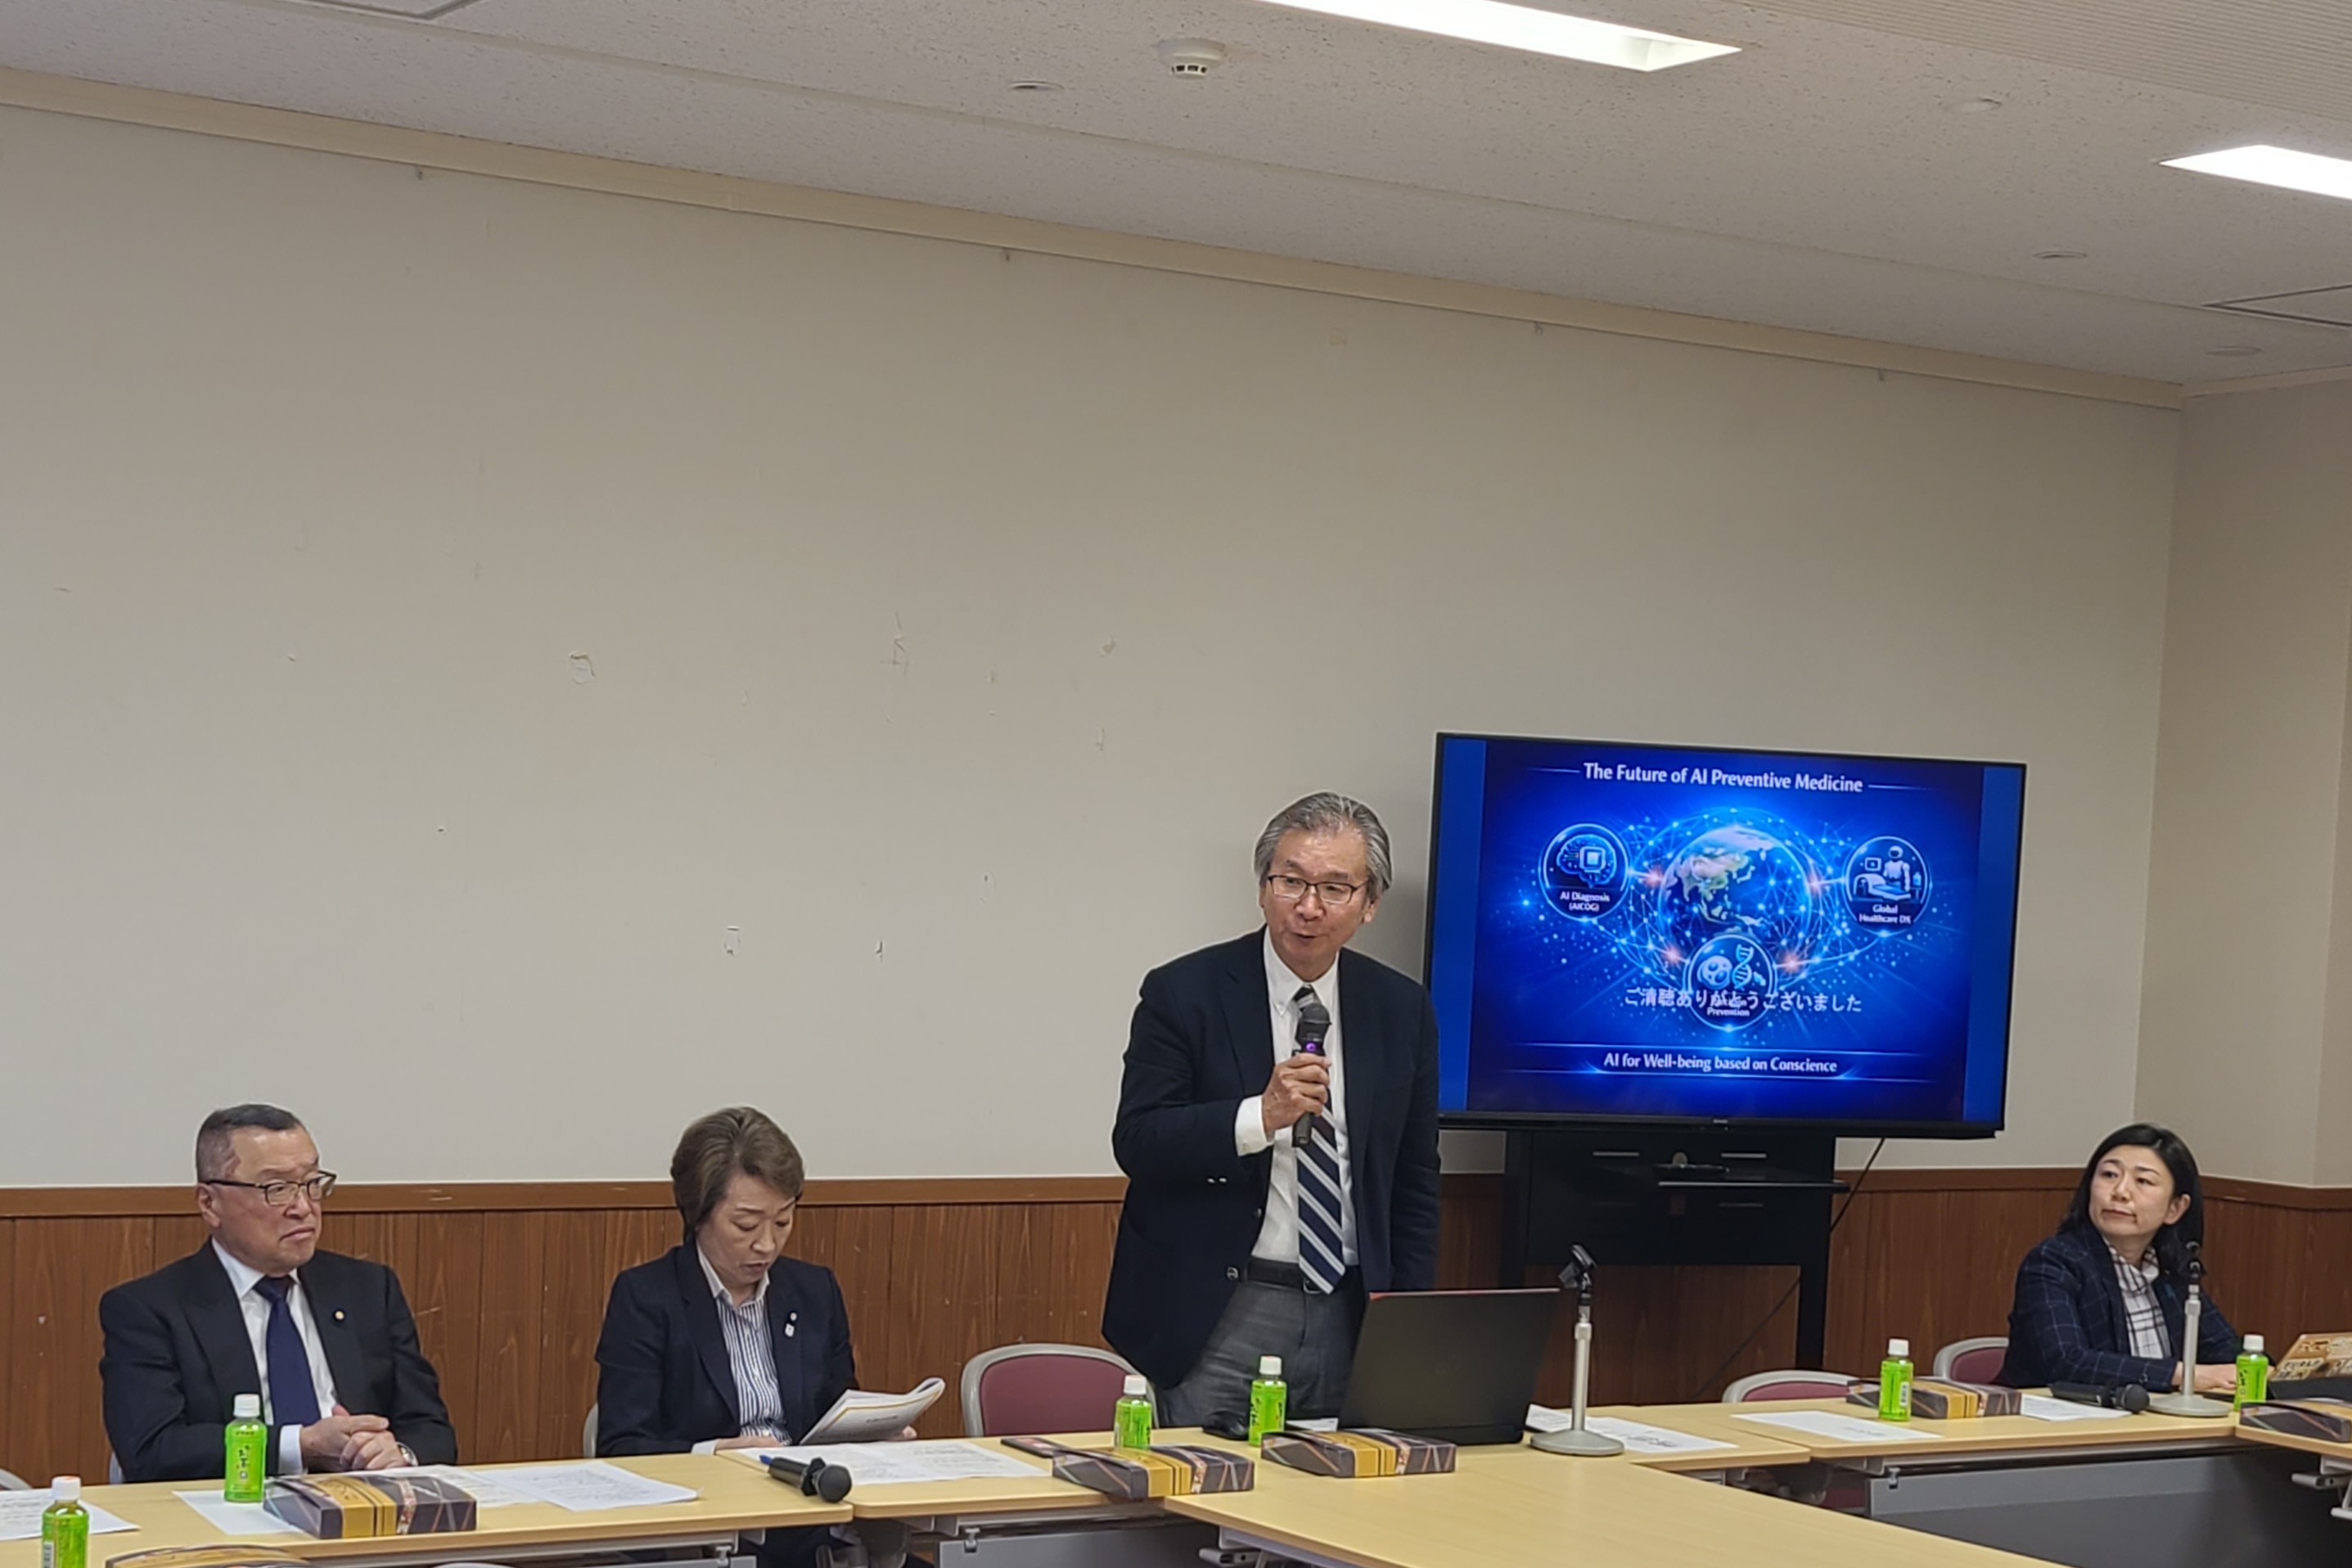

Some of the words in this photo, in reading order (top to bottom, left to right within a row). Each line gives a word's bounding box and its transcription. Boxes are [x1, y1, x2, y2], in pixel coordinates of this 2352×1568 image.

[1584, 762, 1613, 780] The
[1616, 764, 1668, 782] Future
[1670, 768, 1688, 784] of
[1690, 768, 1708, 785] AI
[1711, 768, 1791, 790] Preventive
[1795, 773, 1863, 792] Medicine
[1560, 891, 1570, 900] AI
[1571, 891, 1611, 902] Diagnosis
[1872, 903, 1898, 913] Global
[1859, 912, 1898, 924] Healthcare
[1624, 987, 1863, 1012] ご清聴ありがとうございました
[1706, 1007, 1750, 1017] Prevention
[1604, 1052, 1620, 1067] AI
[1622, 1052, 1642, 1067] for
[1643, 1053, 1712, 1073] Well-being
[1714, 1055, 1750, 1070] based
[1752, 1060, 1768, 1070] on
[1770, 1056, 1838, 1072] Conscience
